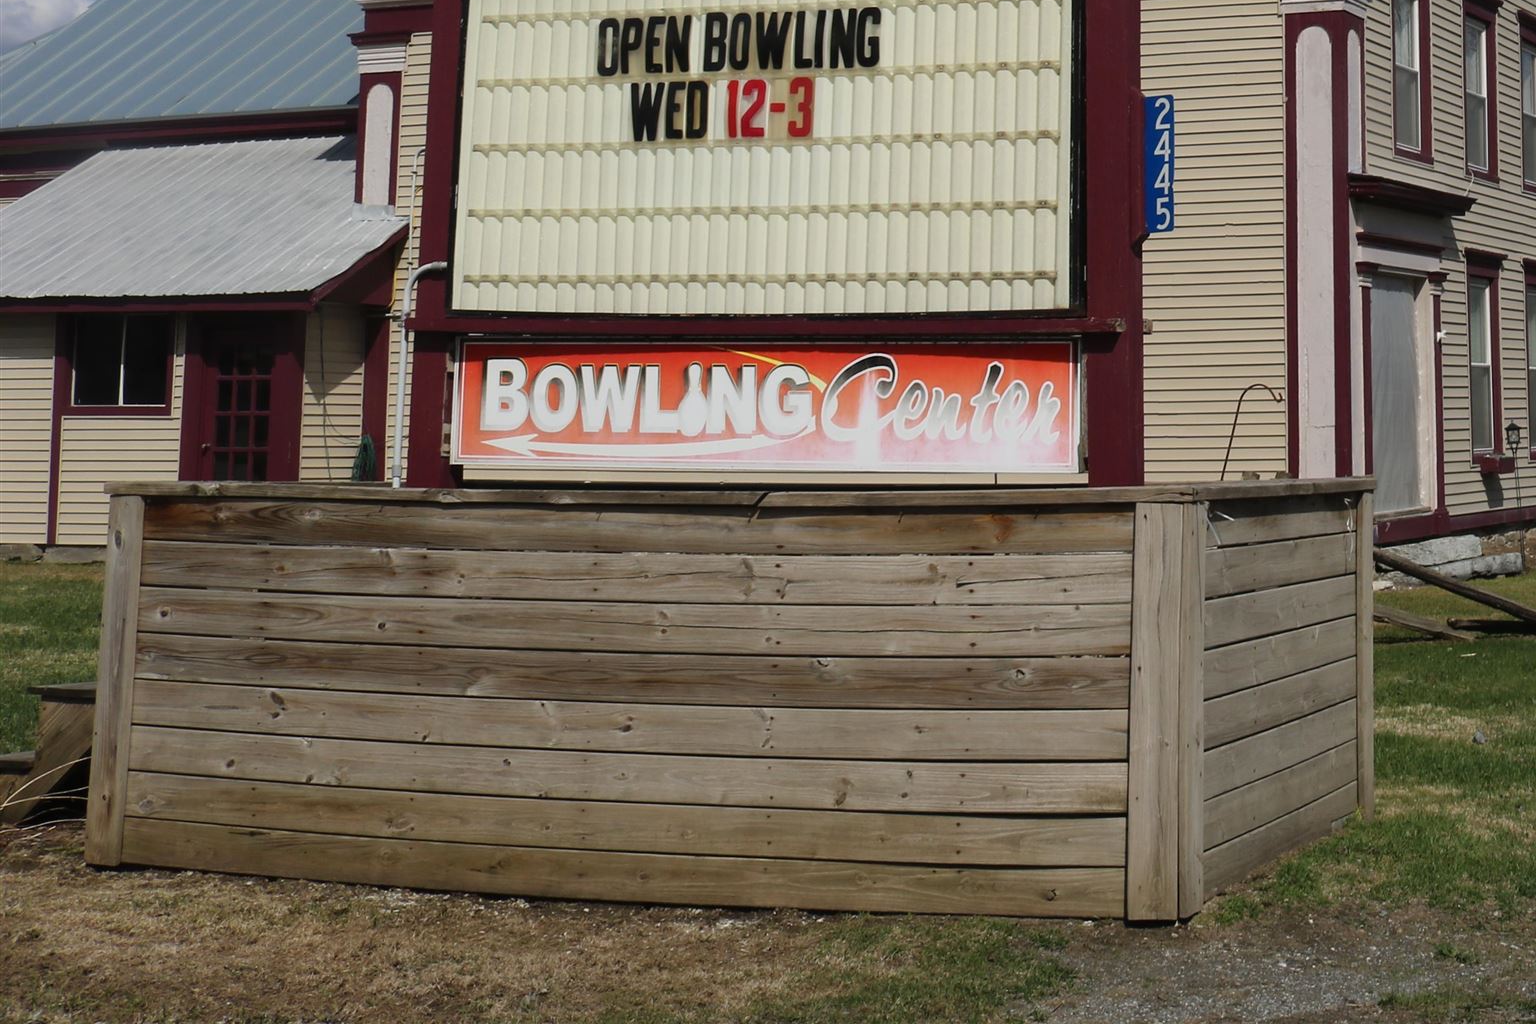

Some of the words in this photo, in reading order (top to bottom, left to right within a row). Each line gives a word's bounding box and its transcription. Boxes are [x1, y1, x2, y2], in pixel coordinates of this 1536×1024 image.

[597, 14, 693, 77] OPEN
[701, 6, 882, 73] BOWLING
[630, 79, 709, 142] WED
[726, 76, 815, 139] 12-3
[1154, 97, 1171, 230] 2445
[480, 355, 815, 440] BOWLING
[821, 351, 1061, 446] Center
